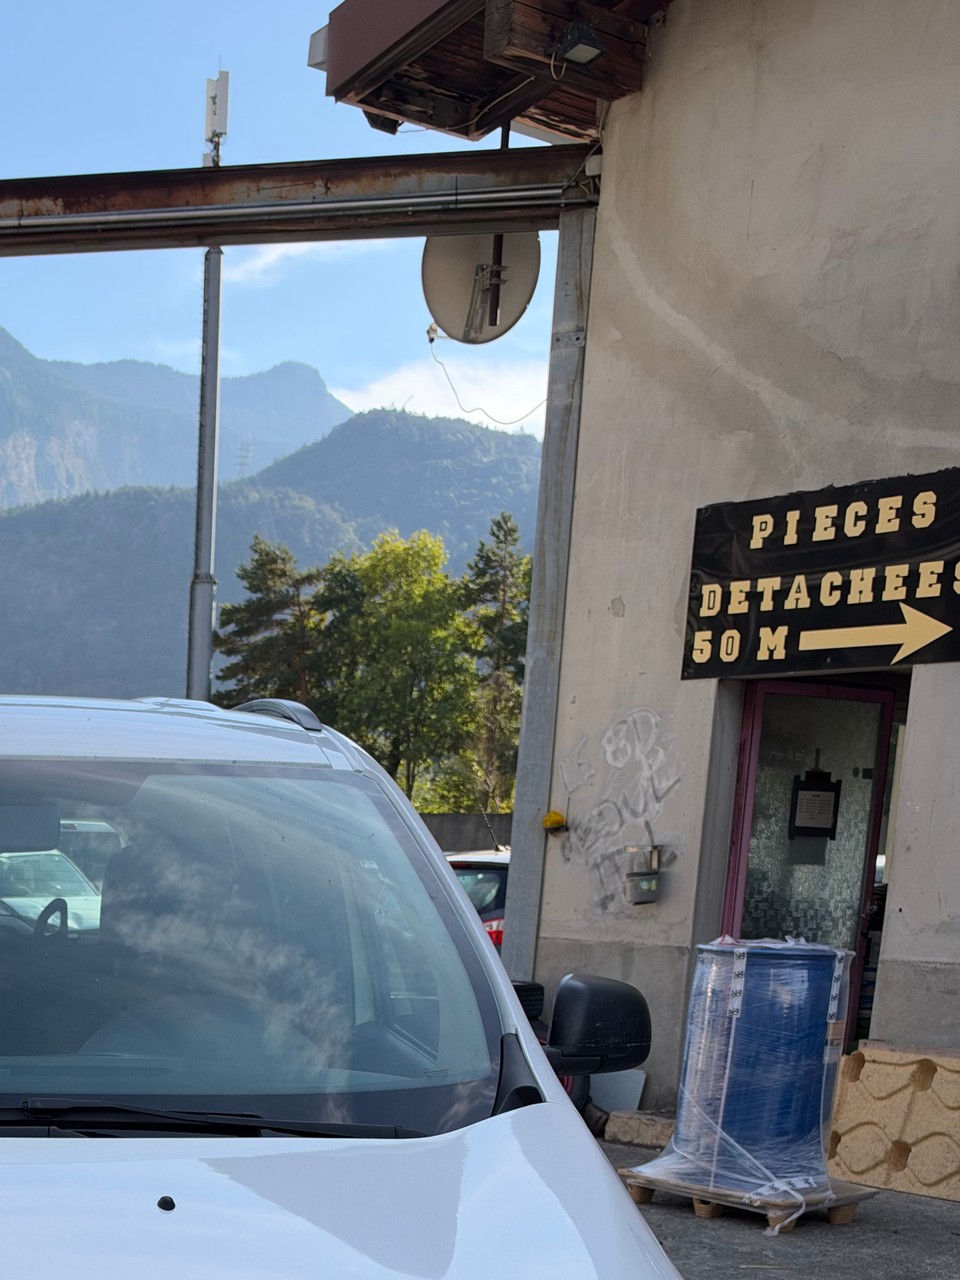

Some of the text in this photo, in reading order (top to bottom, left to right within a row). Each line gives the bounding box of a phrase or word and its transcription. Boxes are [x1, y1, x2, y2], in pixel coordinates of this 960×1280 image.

[749, 490, 937, 550] PIECES
[691, 625, 789, 664] 50 M
